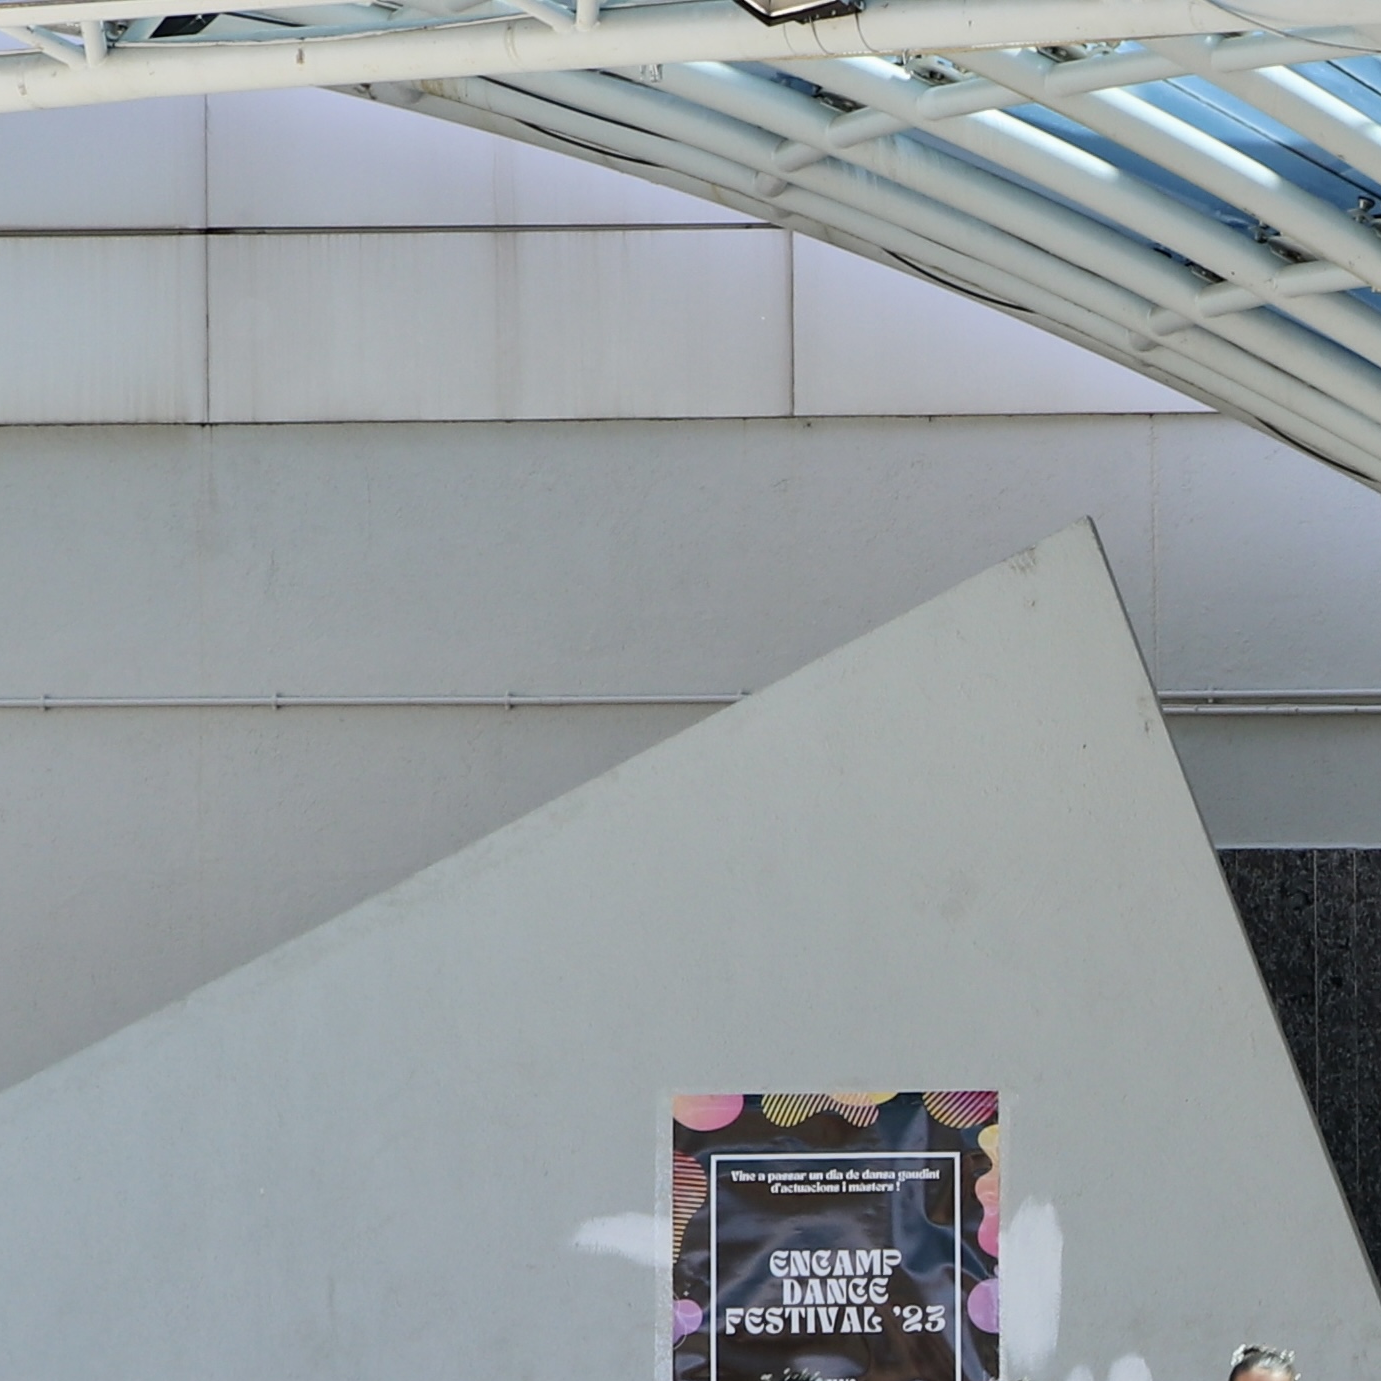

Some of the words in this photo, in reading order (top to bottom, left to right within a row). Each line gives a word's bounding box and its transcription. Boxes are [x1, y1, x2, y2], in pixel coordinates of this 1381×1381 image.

[730, 1170, 756, 1182] Vine
[757, 1173, 766, 1182] a
[767, 1172, 807, 1183] passar
[808, 1171, 824, 1181] un
[825, 1168, 845, 1180] dia
[845, 1168, 861, 1180] de
[861, 1168, 896, 1180] dansa
[897, 1168, 940, 1182] gaudint
[770, 1181, 840, 1194] d'actuacions
[841, 1181, 847, 1193] i
[769, 1249, 902, 1277] ENCAMP
[782, 1278, 889, 1305] DANCE
[725, 1306, 883, 1335] FESTIVAL
[893, 1305, 946, 1333] '23
